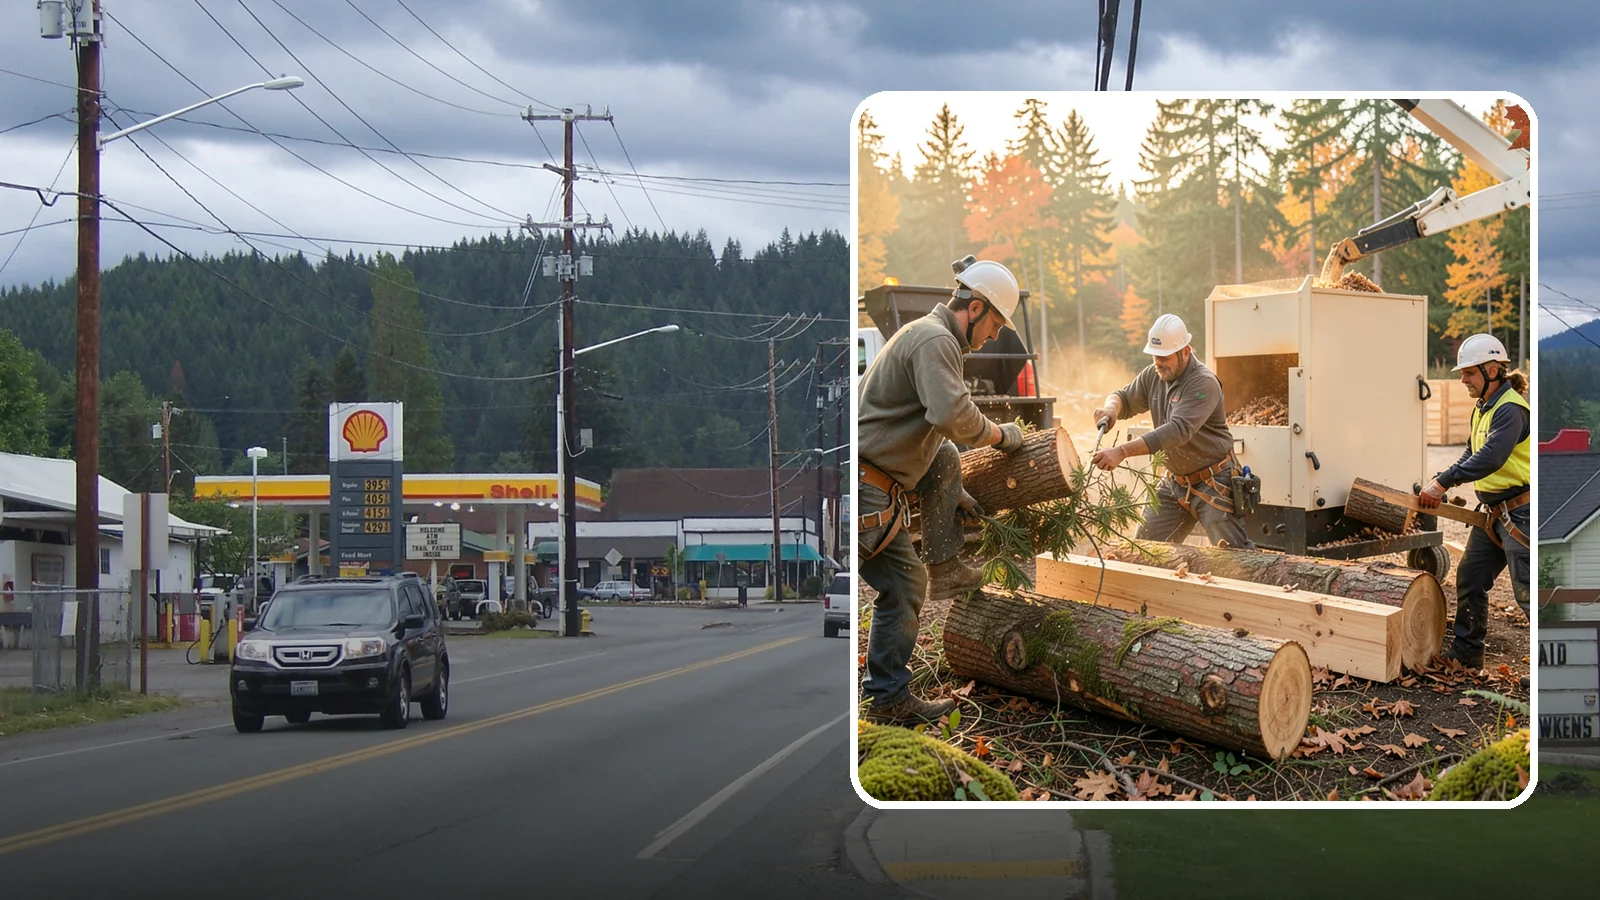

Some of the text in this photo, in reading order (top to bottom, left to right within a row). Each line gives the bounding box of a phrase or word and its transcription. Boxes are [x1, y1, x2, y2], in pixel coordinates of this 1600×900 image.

[365, 480, 383, 490] 395
[490, 484, 547, 499] Shell
[365, 494, 383, 504] 405
[365, 508, 383, 518] 415
[365, 522, 383, 532] 429
